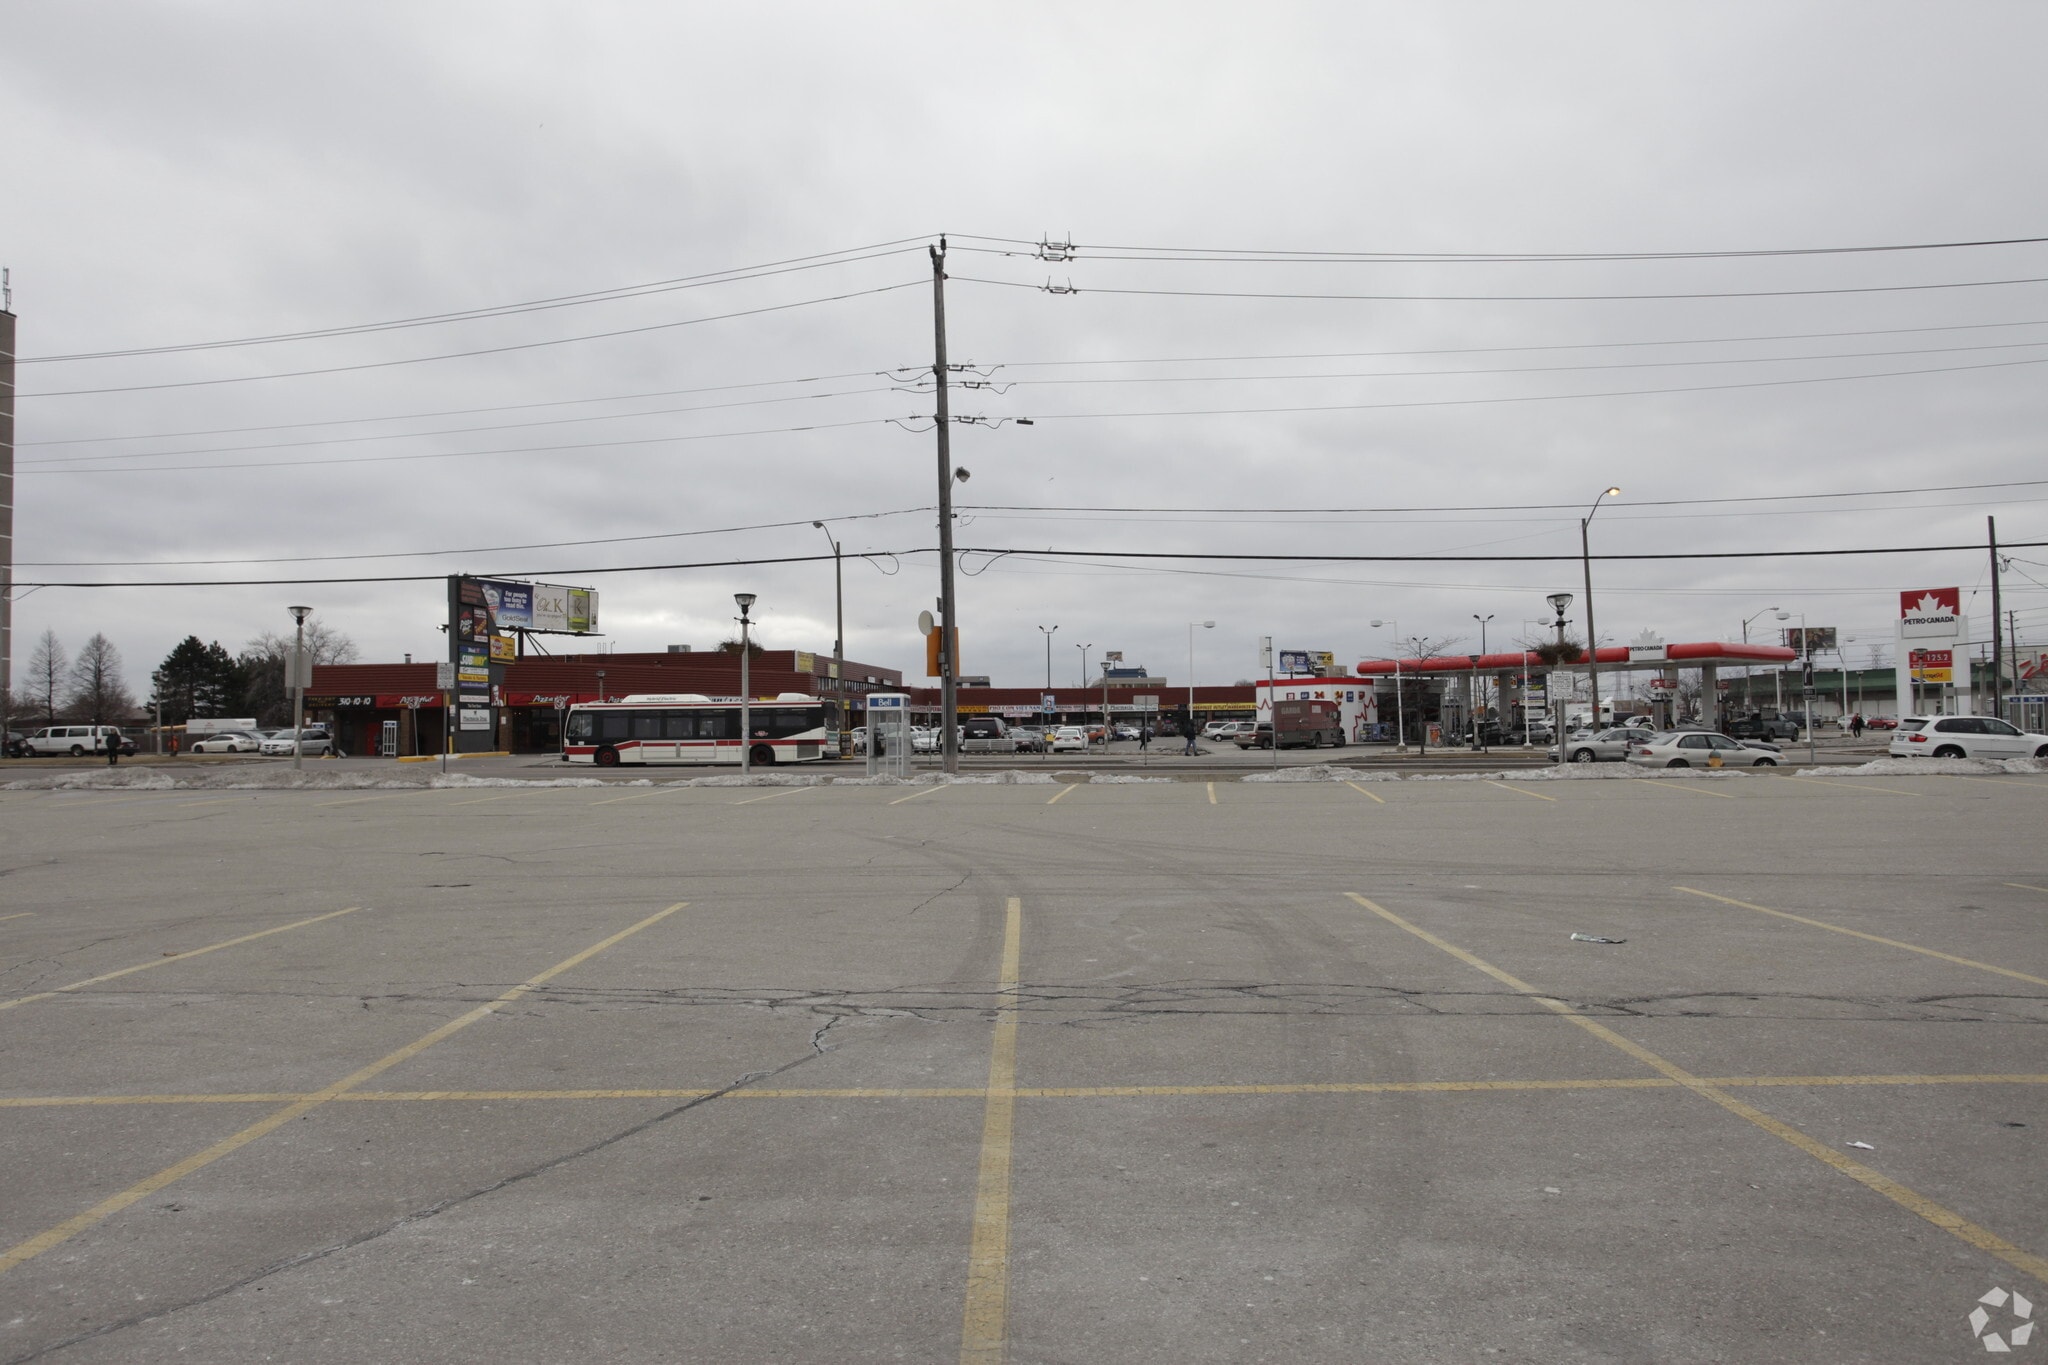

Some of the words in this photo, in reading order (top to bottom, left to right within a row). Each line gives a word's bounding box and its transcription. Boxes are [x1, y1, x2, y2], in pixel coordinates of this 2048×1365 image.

[1904, 616, 1955, 625] PETRO-CANADA
[338, 697, 371, 705] 310-10-10
[878, 698, 892, 706] Bell
